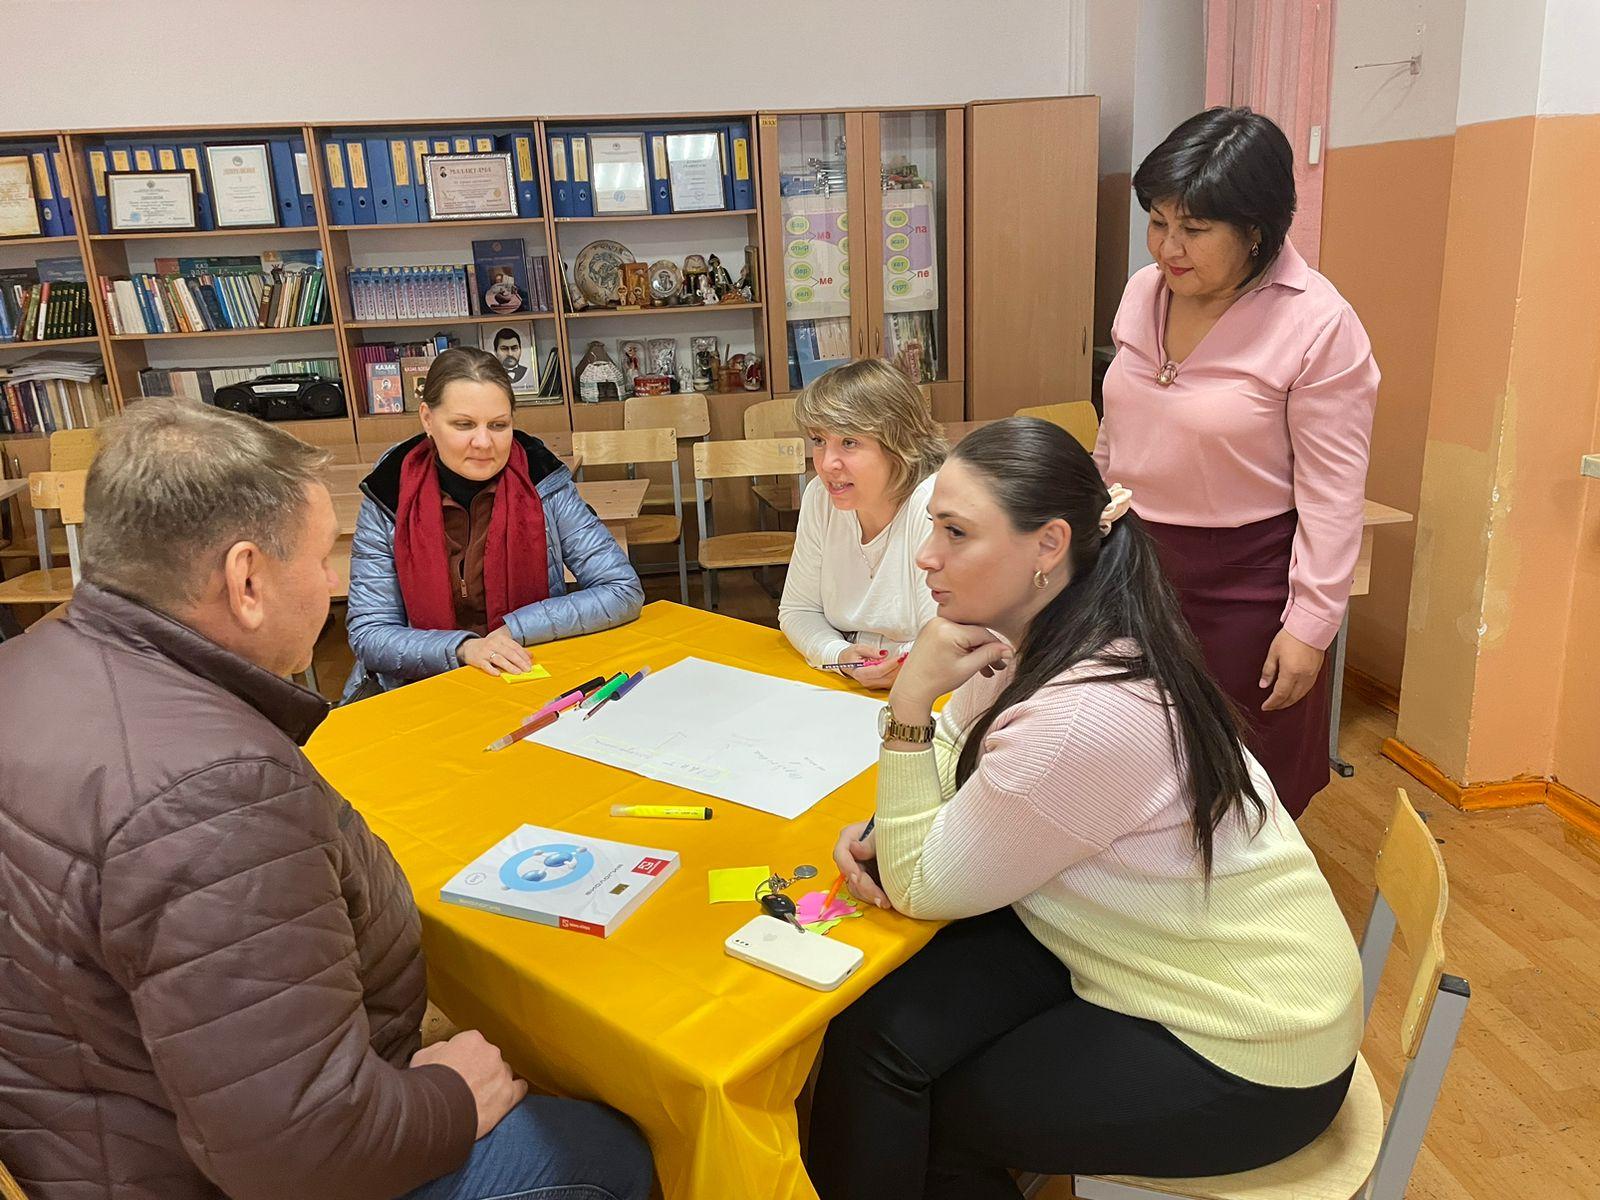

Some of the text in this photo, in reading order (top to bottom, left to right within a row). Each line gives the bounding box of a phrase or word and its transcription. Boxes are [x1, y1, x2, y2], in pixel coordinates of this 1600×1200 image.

[915, 225, 928, 233] па
[917, 269, 930, 277] пе
[819, 276, 833, 285] ме
